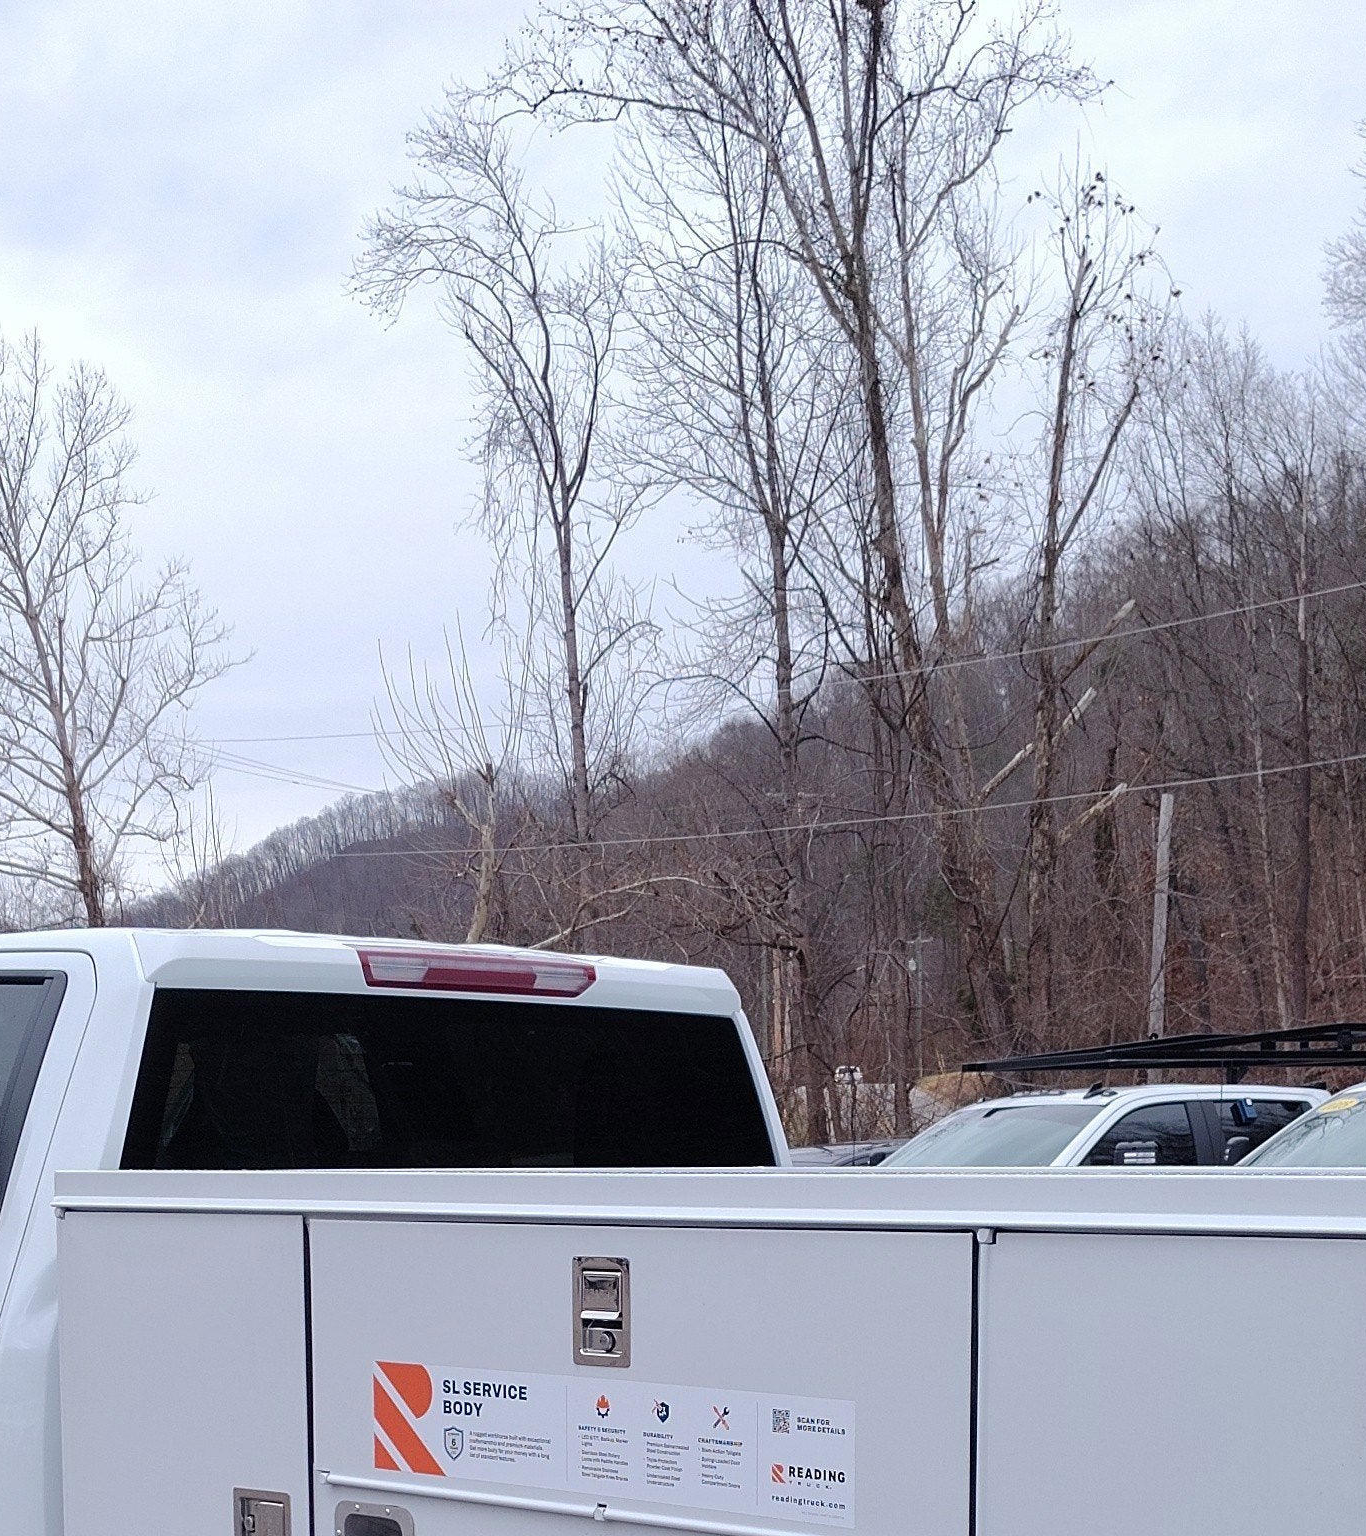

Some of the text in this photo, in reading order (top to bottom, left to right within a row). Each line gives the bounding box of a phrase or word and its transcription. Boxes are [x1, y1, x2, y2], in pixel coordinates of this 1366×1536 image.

[442, 1379, 528, 1401] SL SERVICE
[442, 1400, 483, 1417] BODY
[797, 1417, 814, 1425] SCAN
[817, 1426, 846, 1435] DETAILS
[788, 1466, 846, 1483] READING
[771, 1495, 846, 1510] readingtruck.com
